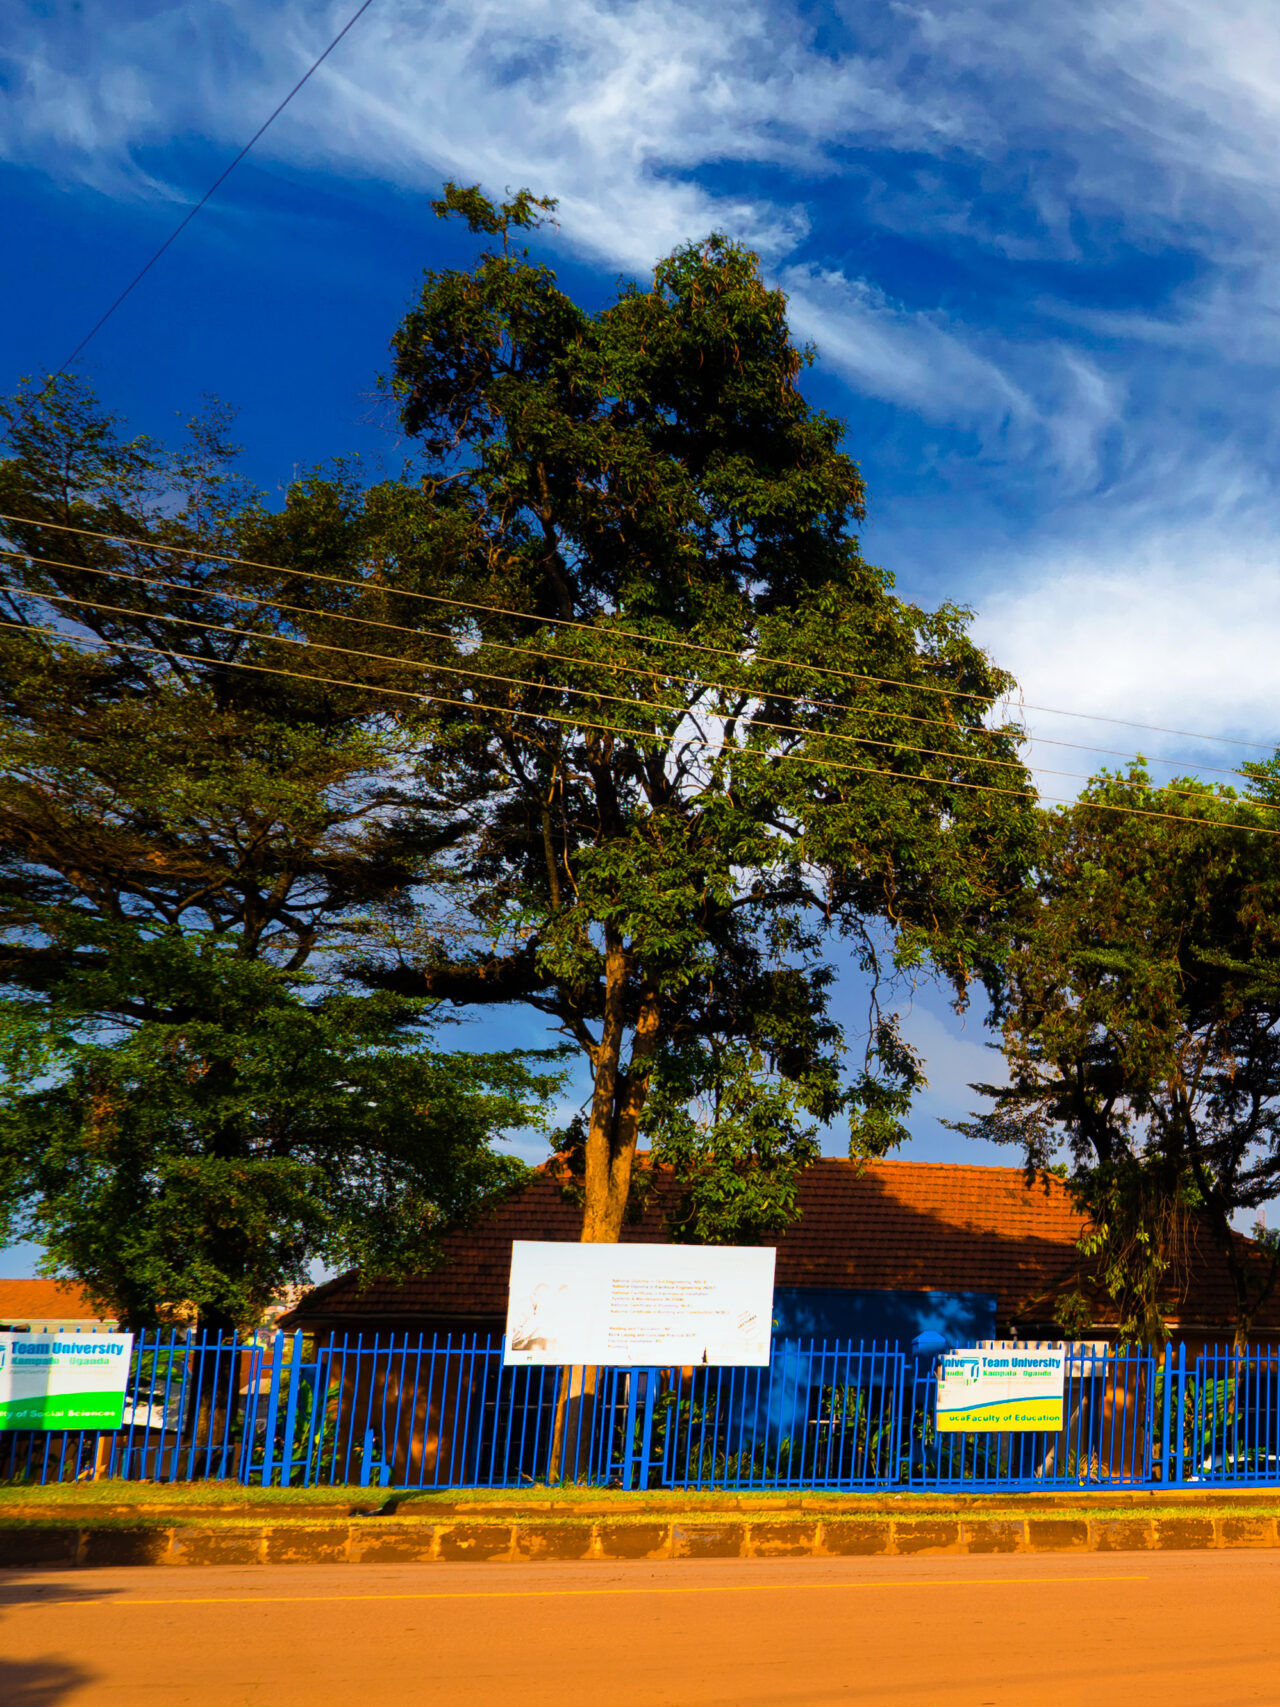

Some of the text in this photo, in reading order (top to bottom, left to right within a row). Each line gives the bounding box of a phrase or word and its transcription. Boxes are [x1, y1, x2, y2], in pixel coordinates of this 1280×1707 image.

[12, 1341, 124, 1356] Team University
[70, 1357, 110, 1366] Uganda
[982, 1357, 1061, 1369] Team University
[1023, 1370, 1052, 1378] Uganda
[15, 1410, 28, 1418] of
[30, 1410, 64, 1418] Social
[966, 1414, 1000, 1423] Faculty
[1003, 1414, 1012, 1422] of
[1015, 1414, 1060, 1422] Education
